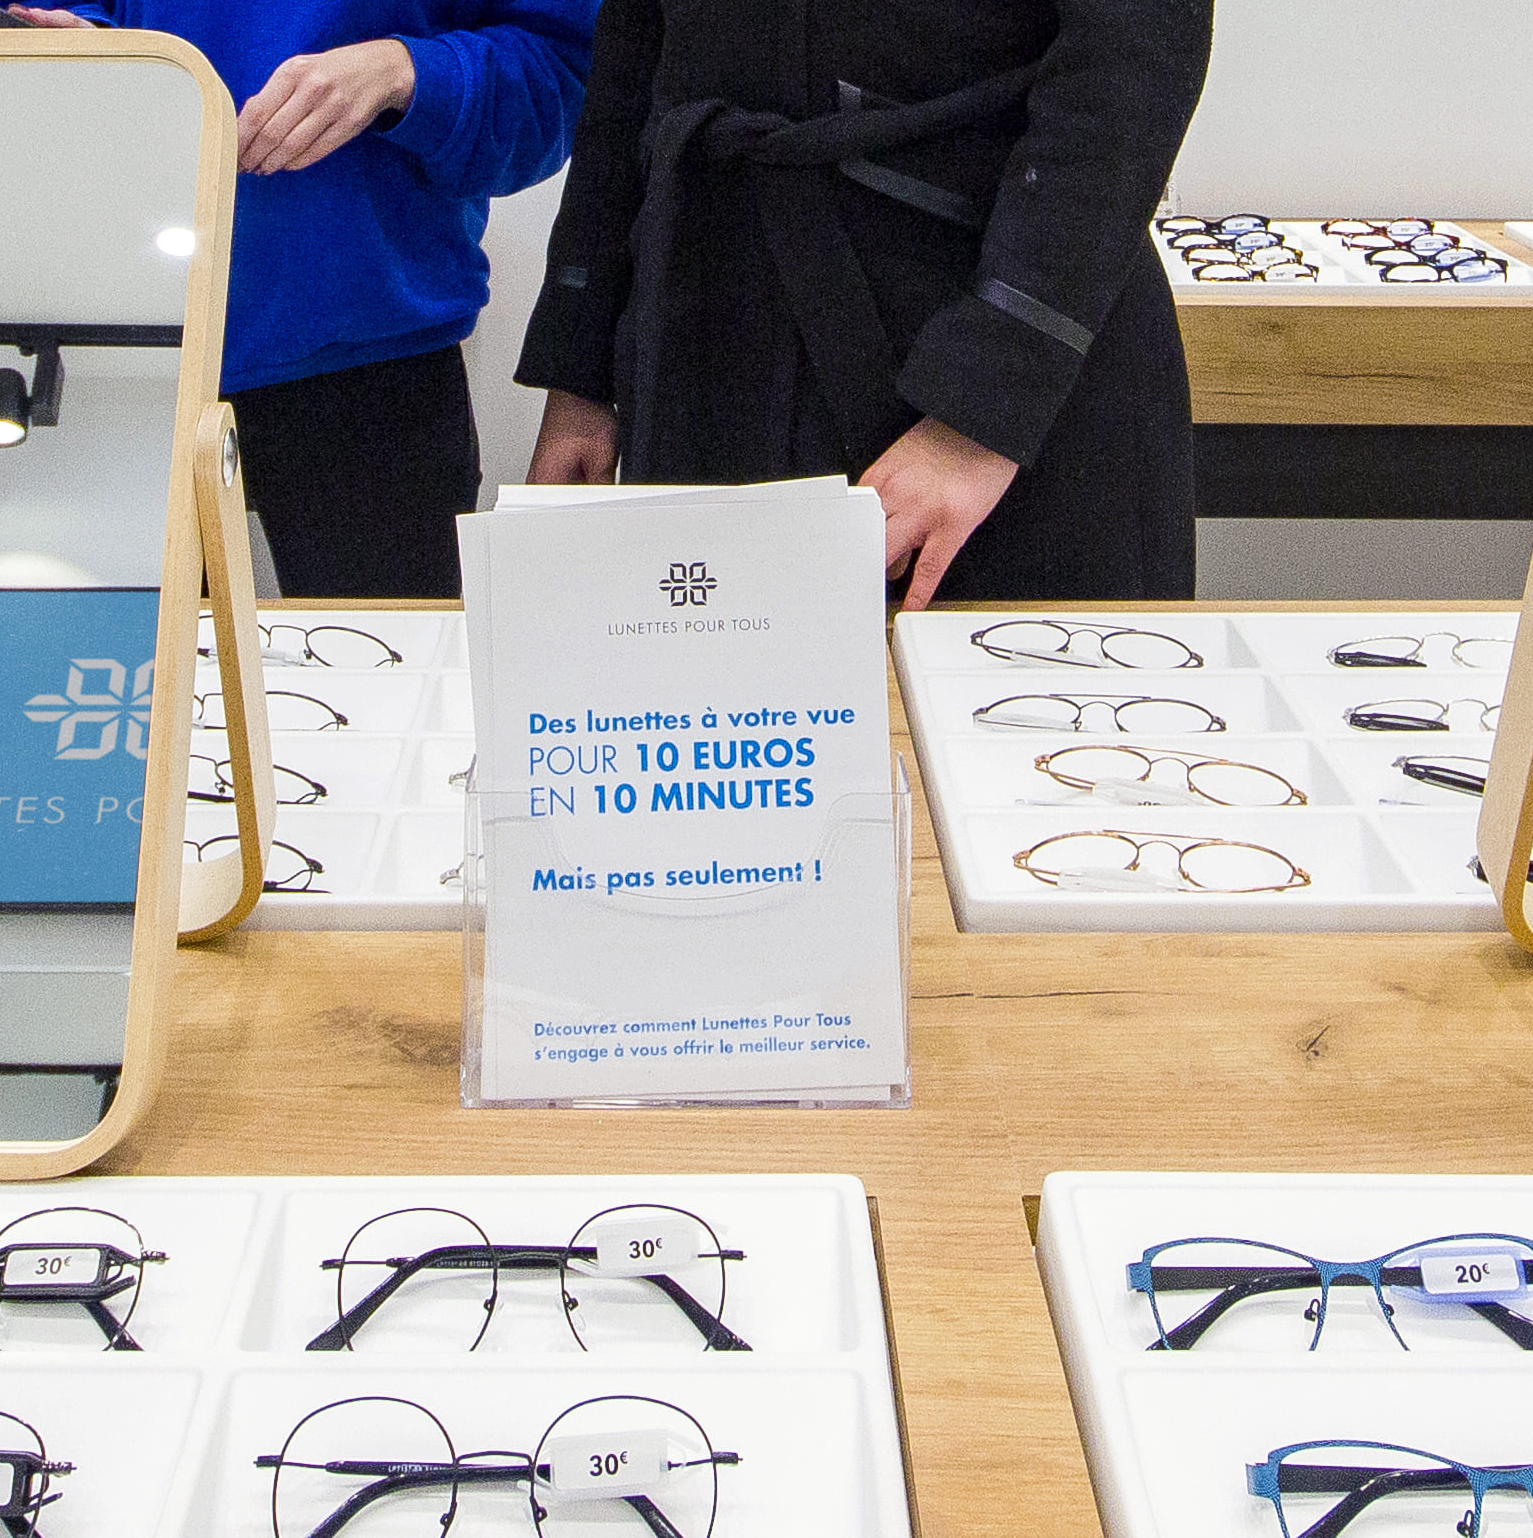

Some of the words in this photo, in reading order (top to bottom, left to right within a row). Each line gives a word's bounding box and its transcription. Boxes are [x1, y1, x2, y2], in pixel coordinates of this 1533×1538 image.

[608, 621, 678, 636] LUNETTES
[684, 619, 725, 633] POUR
[731, 617, 771, 632] TOUS
[529, 713, 577, 735] Des
[587, 709, 692, 733] lunettes
[701, 706, 718, 729] à
[727, 707, 797, 728] votre
[807, 705, 855, 725] vue
[529, 744, 618, 776] POUR
[636, 741, 679, 772] 10
[693, 737, 815, 770] EUROS
[530, 786, 575, 817] EN
[594, 783, 637, 814] 10
[650, 777, 814, 812] MINUTES
[532, 866, 595, 891] Mais
[607, 871, 655, 896] pas
[665, 860, 803, 887] seulement
[534, 1022, 617, 1037] Découvrez
[623, 1018, 697, 1034] comment
[702, 1017, 768, 1031] Lunettes
[773, 1014, 811, 1028] Pour
[815, 1012, 852, 1027] Tous
[613, 1042, 625, 1058] à
[629, 1045, 668, 1057] vous
[673, 1039, 714, 1056] offrir
[719, 1038, 734, 1054] le
[739, 1036, 805, 1053] meilleur
[810, 1034, 871, 1051] service.
[629, 1238, 662, 1260] 30€
[35, 1256, 71, 1276] 30€
[1455, 1263, 1490, 1284] 20€
[589, 1451, 628, 1477] 30€
